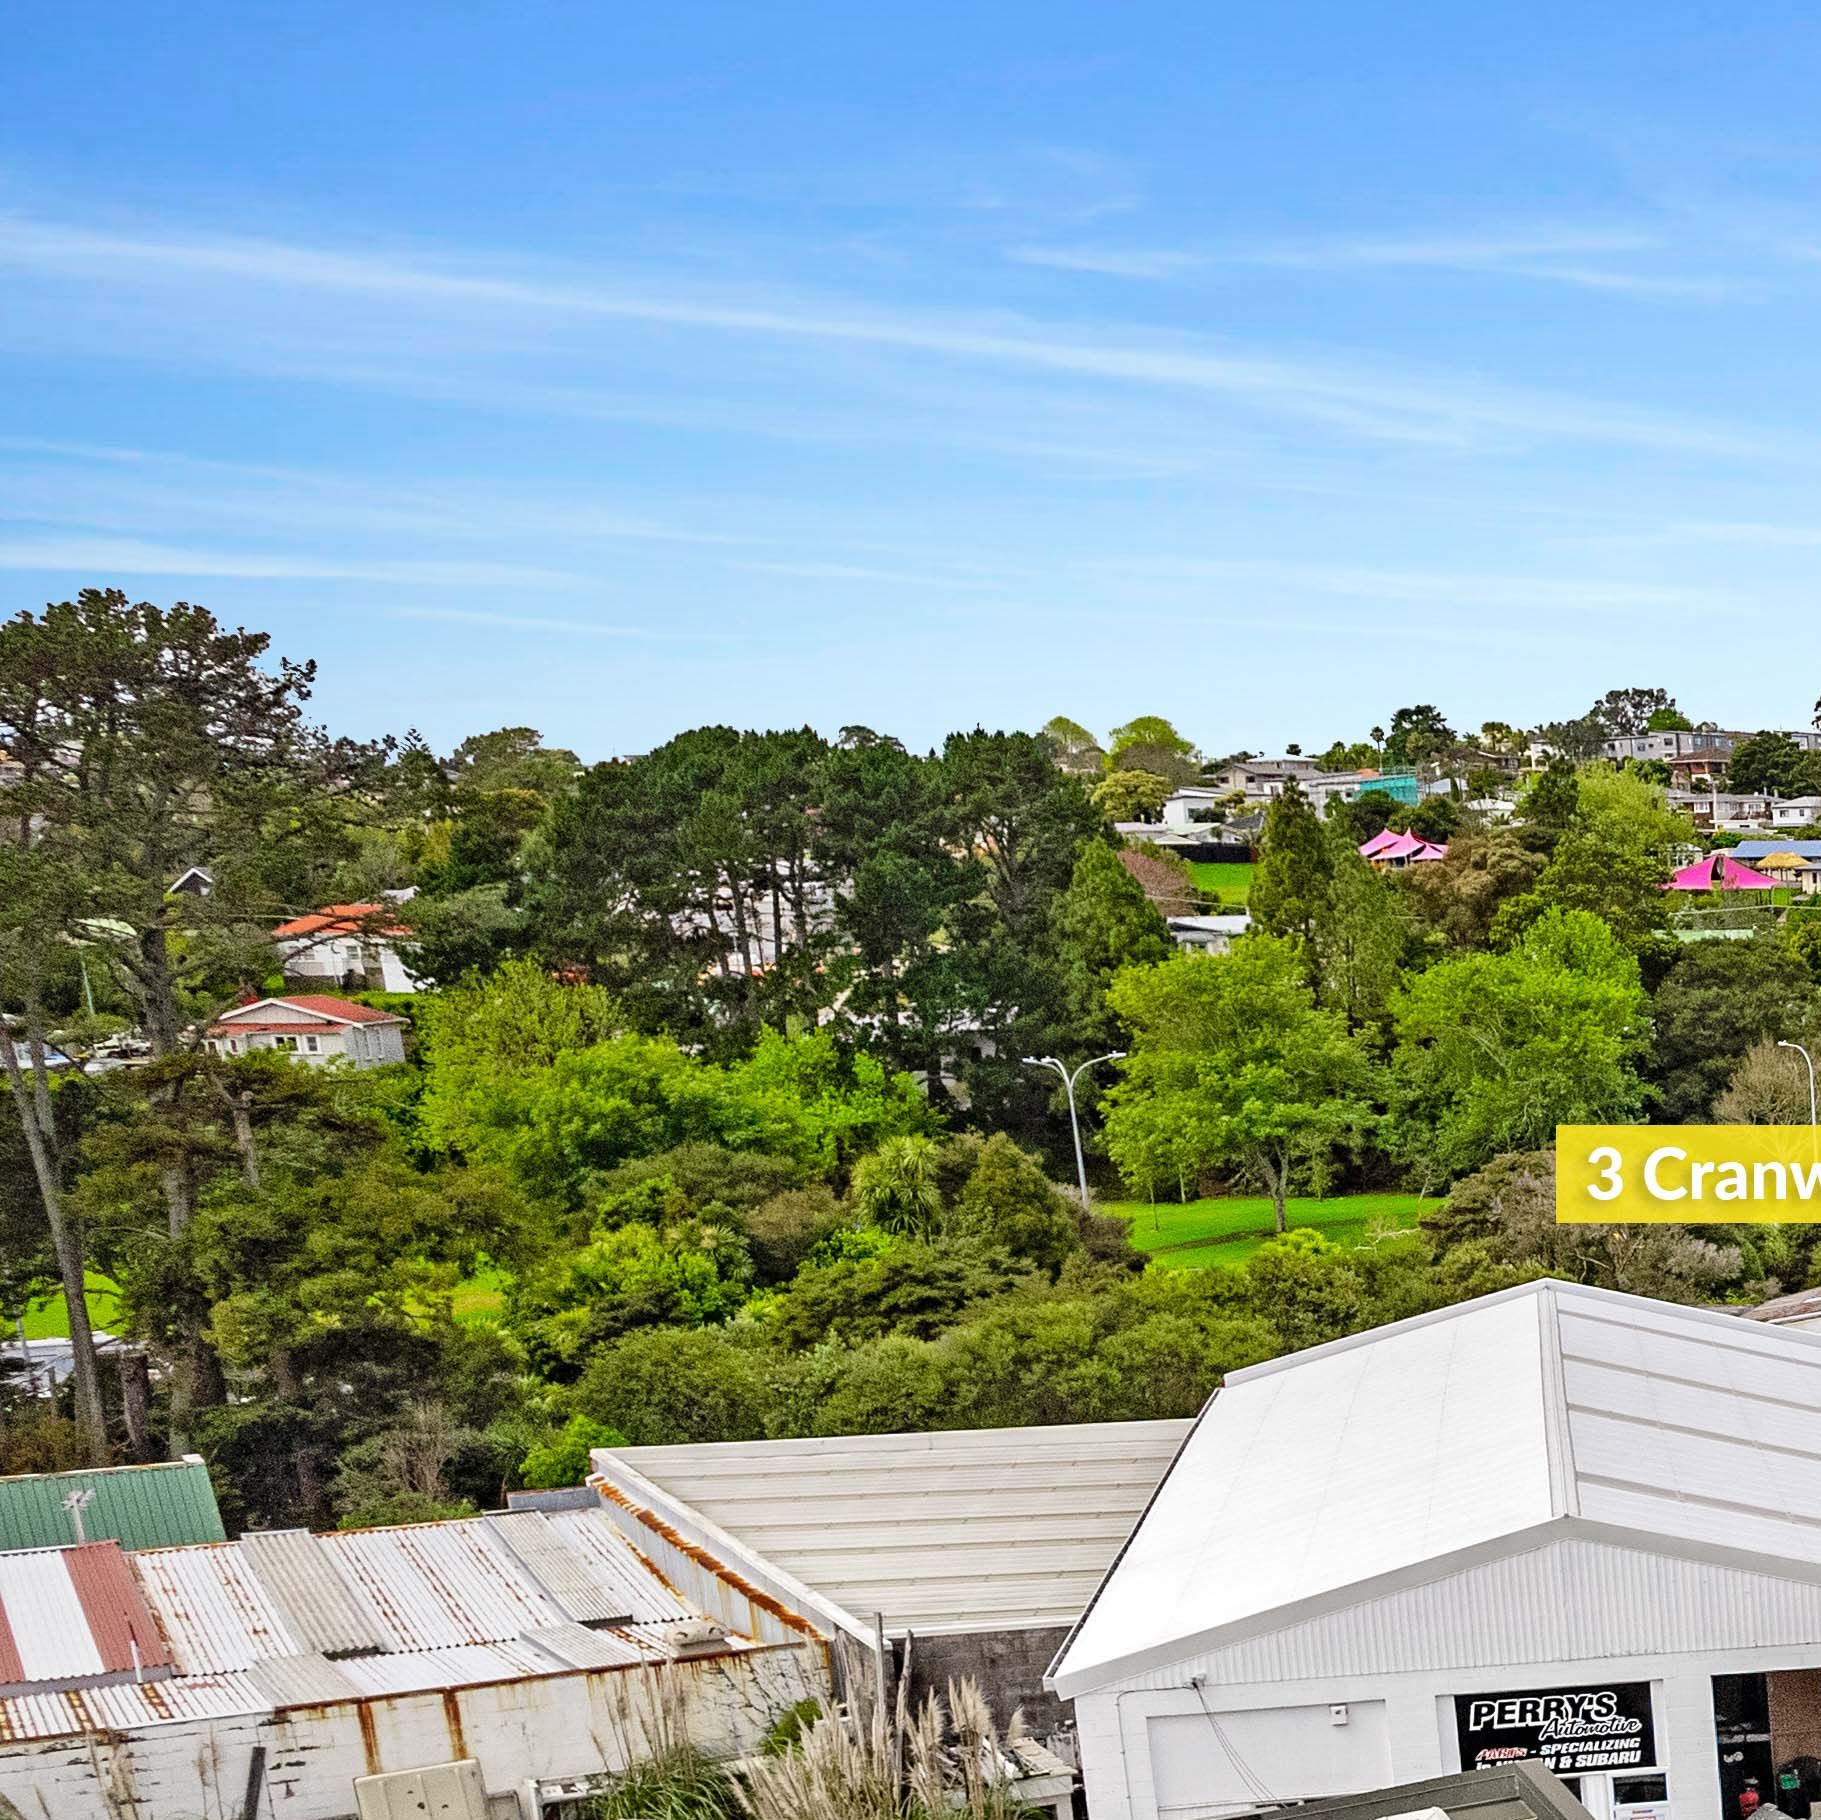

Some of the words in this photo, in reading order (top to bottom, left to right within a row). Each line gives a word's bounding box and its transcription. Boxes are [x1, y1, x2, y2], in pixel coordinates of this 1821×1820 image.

[1469, 1692, 1617, 1732] PERRY'S
[1538, 1715, 1642, 1741] Automotive
[1539, 1738, 1641, 1756] SPECIALIZING
[1559, 1756, 1573, 1769] &
[1575, 1750, 1642, 1768] SUBARU
